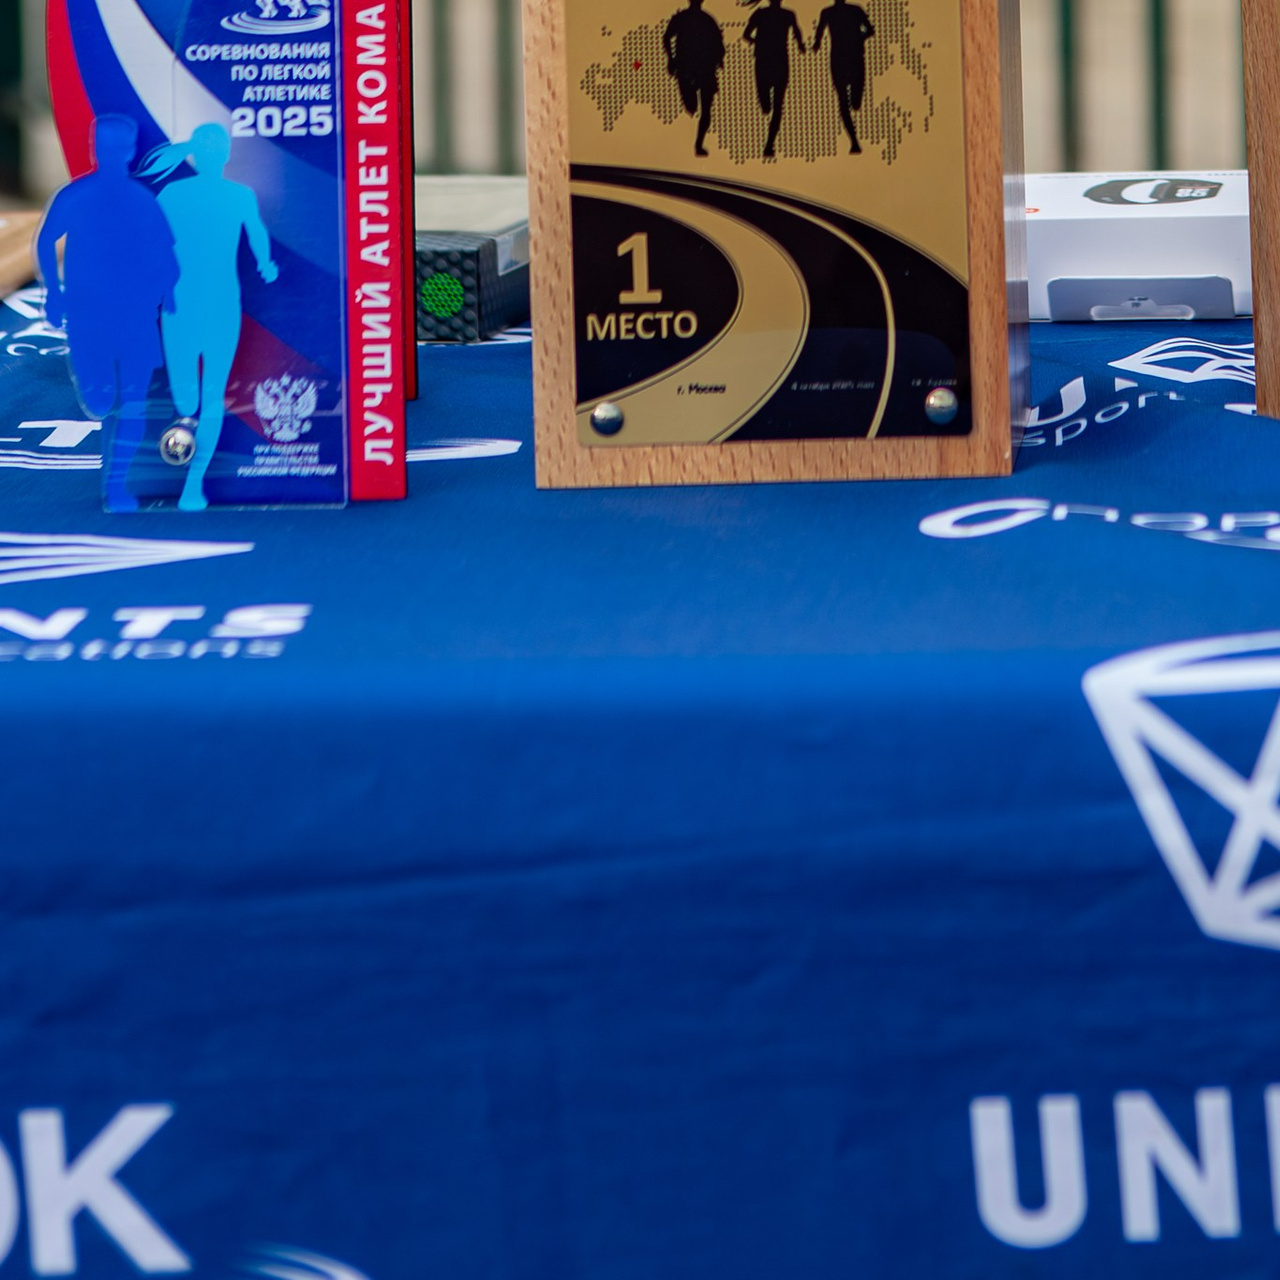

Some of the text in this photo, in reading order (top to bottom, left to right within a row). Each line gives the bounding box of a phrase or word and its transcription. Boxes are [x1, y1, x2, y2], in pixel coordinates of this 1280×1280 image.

[185, 42, 331, 61] СОРЕВНОВАНИЯ
[231, 60, 331, 81] ПО ЛЕГКОЙ
[242, 84, 332, 102] АТЛЕТИКЕ
[231, 105, 333, 137] 2025
[358, 139, 390, 267] АТЛЕТ
[617, 232, 662, 304] 1
[586, 310, 698, 341] МЕСТО
[355, 281, 394, 465] ЛУЧШИЙ
